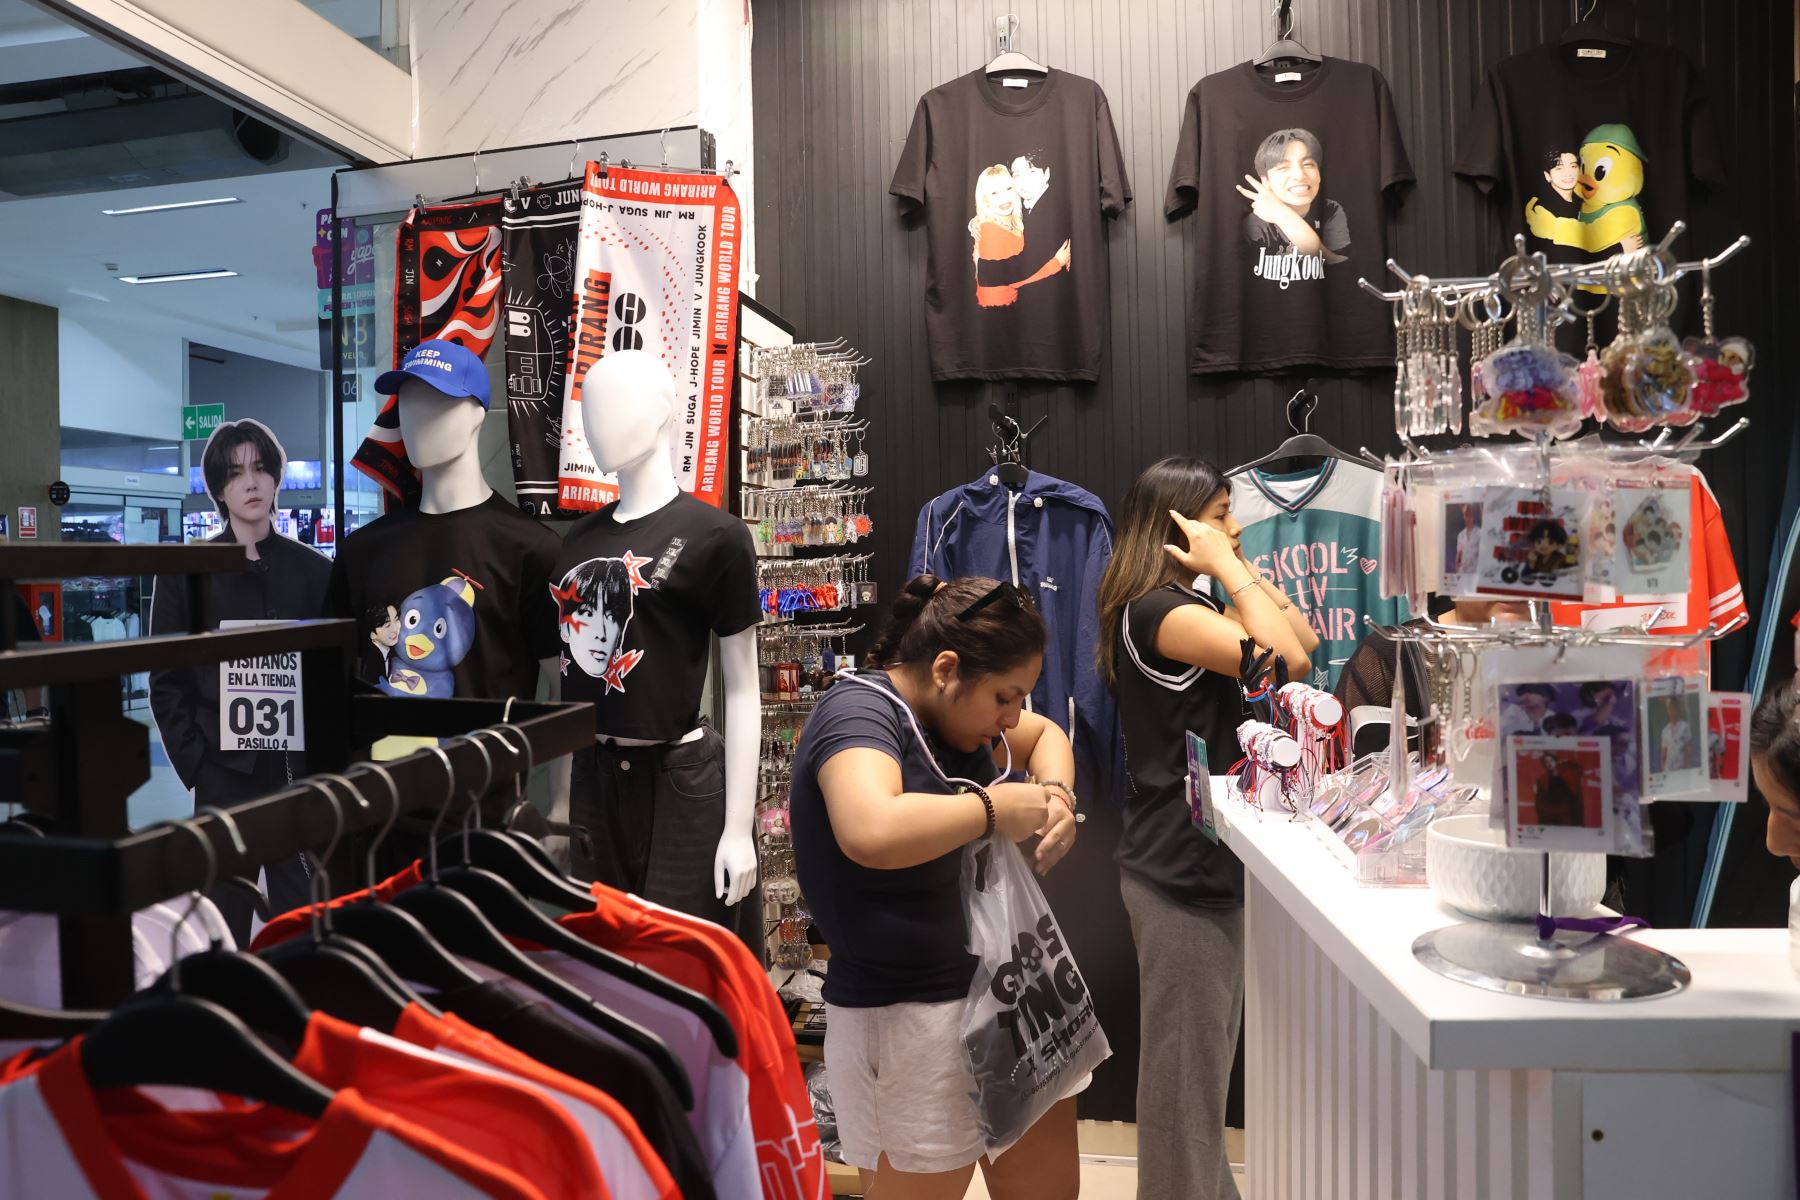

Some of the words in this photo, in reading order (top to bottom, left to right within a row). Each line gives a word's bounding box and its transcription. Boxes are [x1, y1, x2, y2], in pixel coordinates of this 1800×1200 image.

[619, 179, 661, 196] WORLD
[664, 184, 717, 198] ARIRANG
[582, 199, 614, 213] J-HOP
[619, 206, 648, 217] SUGA
[654, 210, 672, 219] JIN
[678, 211, 695, 220] RM
[720, 206, 736, 238] TOUR
[695, 225, 707, 287] JUNGKOOK
[717, 241, 734, 284] WORLD
[405, 268, 415, 285] JIN
[694, 293, 703, 301] V
[714, 286, 731, 340] ARIRANG
[692, 308, 701, 339] JIMIN
[415, 349, 441, 359] KEEP
[403, 357, 453, 372] SWIMMING
[690, 346, 700, 388] J-HOPE
[711, 359, 726, 391] TOUR
[686, 394, 697, 425] SUGA
[707, 394, 724, 437] WORLD
[685, 431, 694, 449] JIN
[564, 463, 595, 474] JIMIN
[682, 455, 692, 473] RM
[701, 440, 720, 493] ARIRANG
[562, 485, 614, 503] ARIRANG
[228, 673, 242, 686] EN
[245, 673, 258, 686] LA
[261, 674, 296, 687] TIENDA
[229, 697, 295, 736] 031
[238, 738, 279, 750] PASILLO
[282, 739, 288, 750] 4
